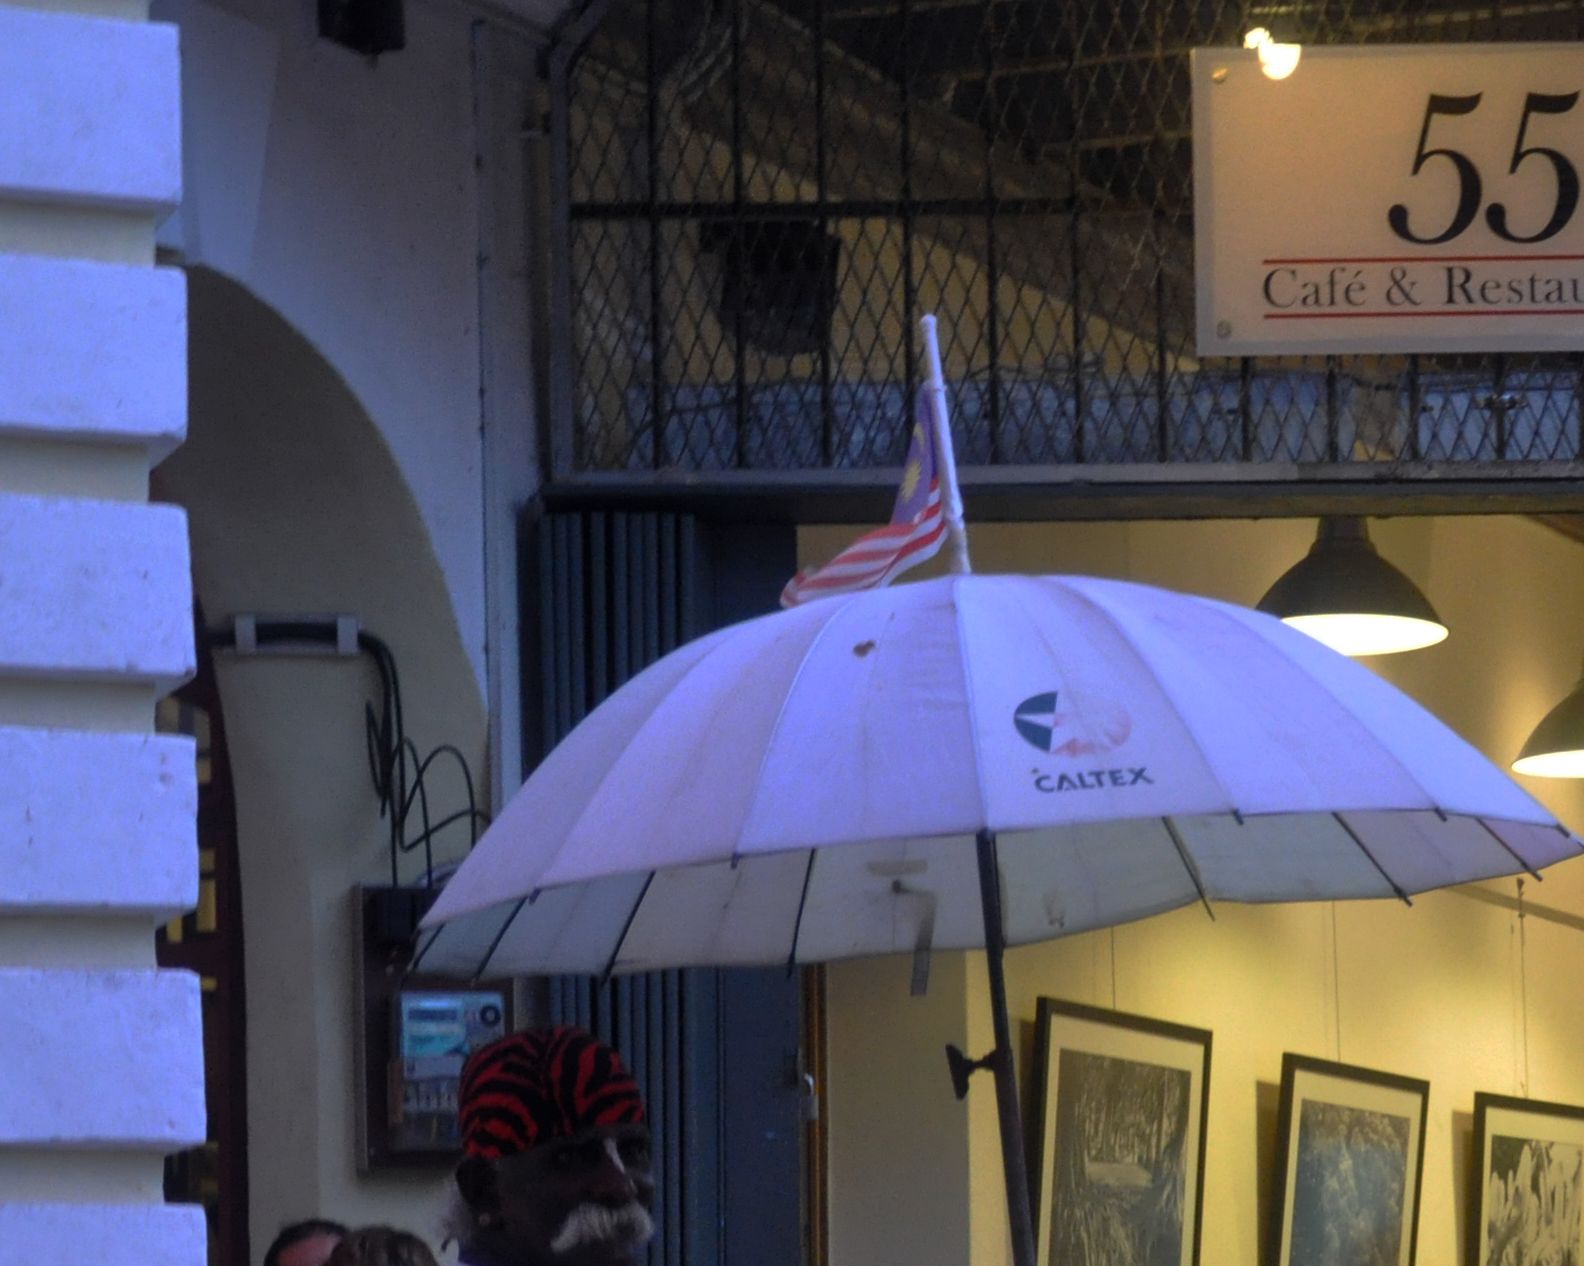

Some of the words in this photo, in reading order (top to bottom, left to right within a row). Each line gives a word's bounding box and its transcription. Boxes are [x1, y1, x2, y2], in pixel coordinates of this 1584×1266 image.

[1387, 89, 1581, 245] 55
[1262, 265, 1367, 309] Café
[1385, 265, 1423, 307] &
[1034, 766, 1155, 794] CALTEX
